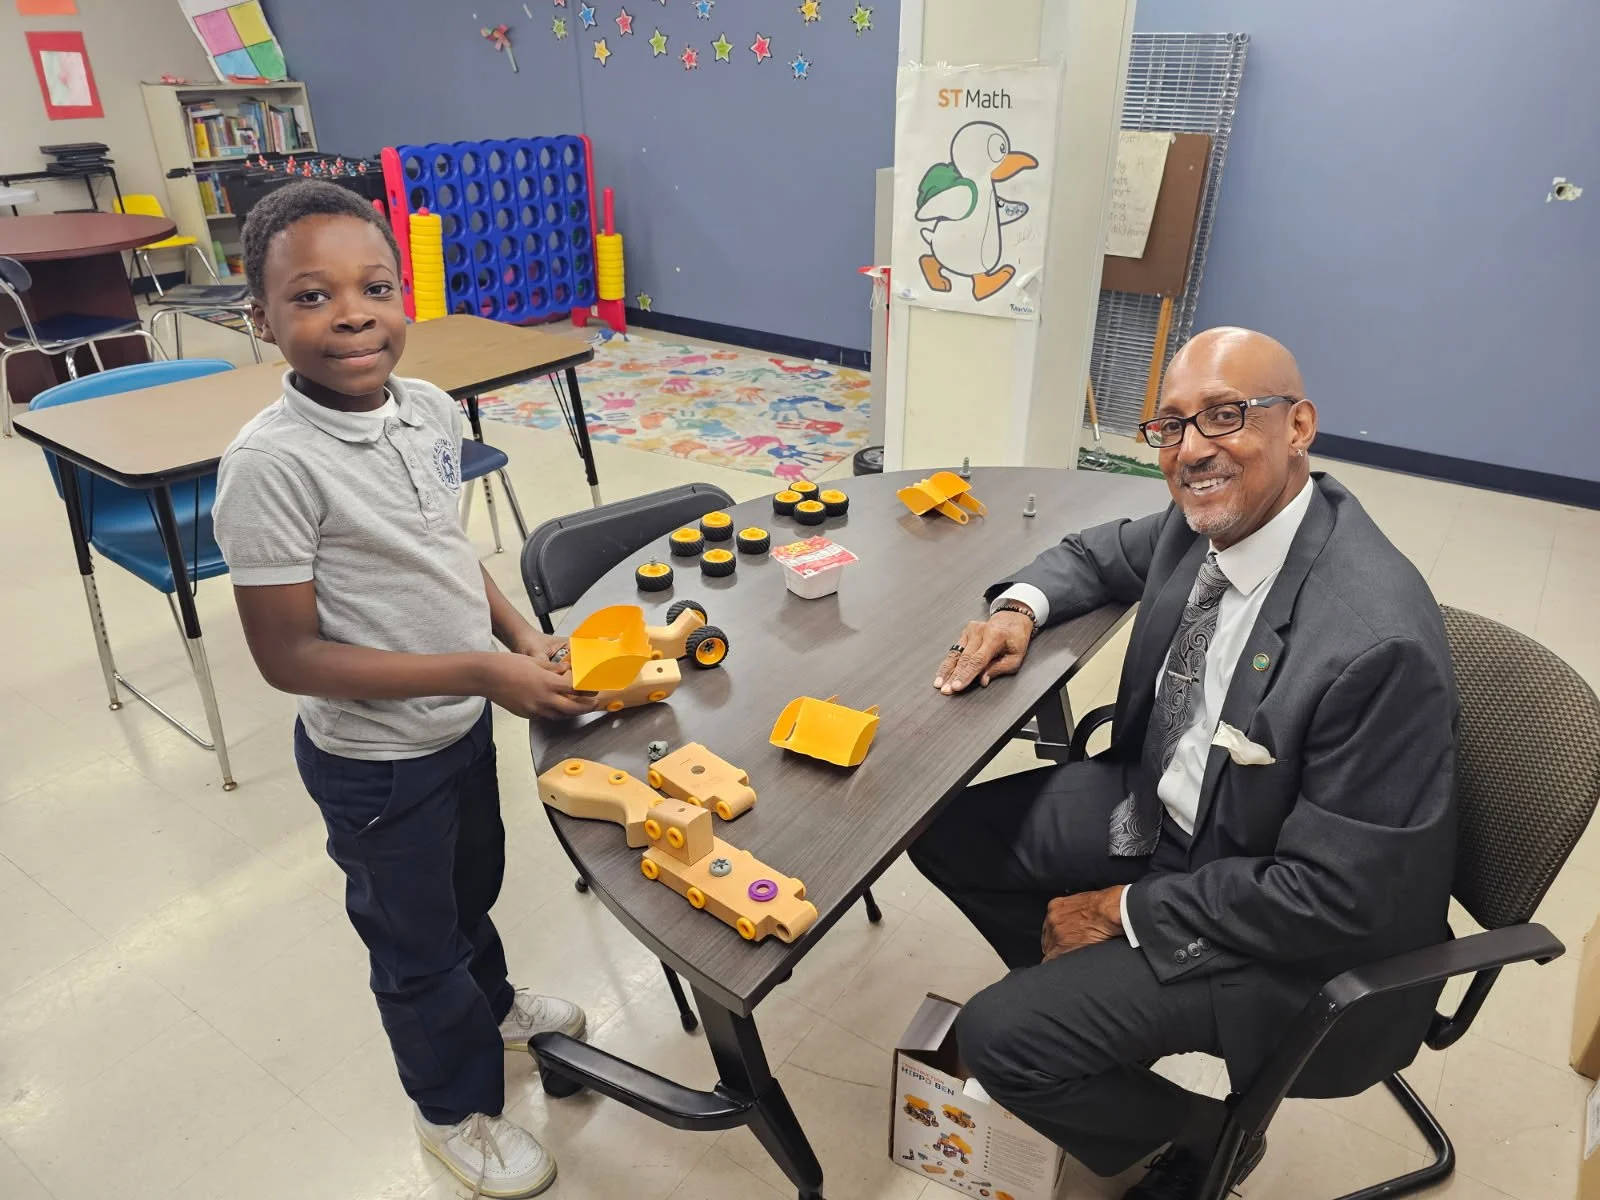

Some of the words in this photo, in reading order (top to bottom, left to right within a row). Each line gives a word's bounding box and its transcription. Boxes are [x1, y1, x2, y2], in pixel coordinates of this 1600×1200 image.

[938, 88, 963, 108] ST
[965, 88, 1011, 109] Math
[934, 1082, 955, 1096] BEN
